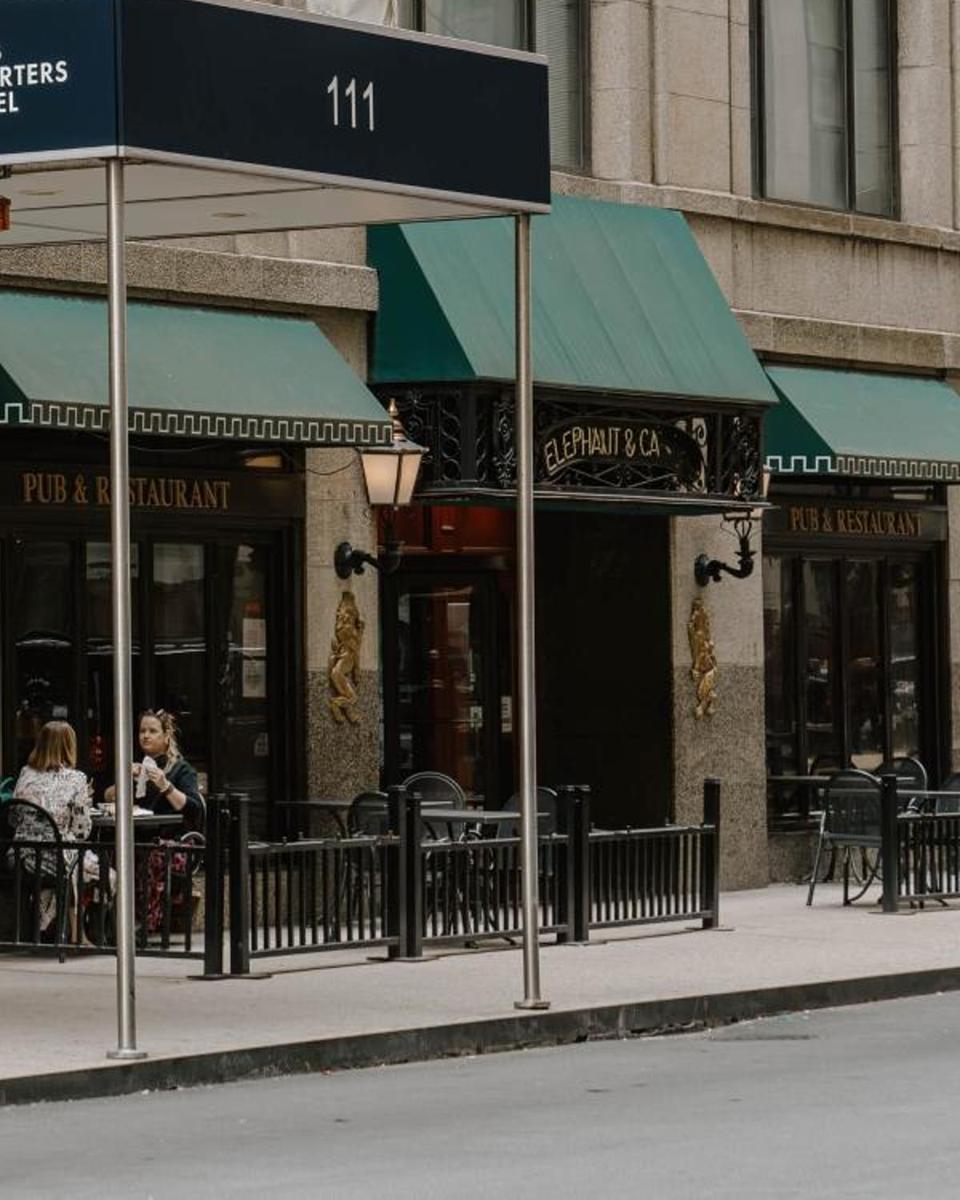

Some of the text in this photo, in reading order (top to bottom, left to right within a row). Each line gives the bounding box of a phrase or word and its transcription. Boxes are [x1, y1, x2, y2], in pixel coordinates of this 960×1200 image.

[327, 75, 374, 131] 111
[544, 426, 621, 472] ELEPHANT
[625, 428, 636, 457] &
[23, 473, 231, 510] PUB & RSTAURANT
[790, 506, 922, 537] PUB & RESTAURANT
